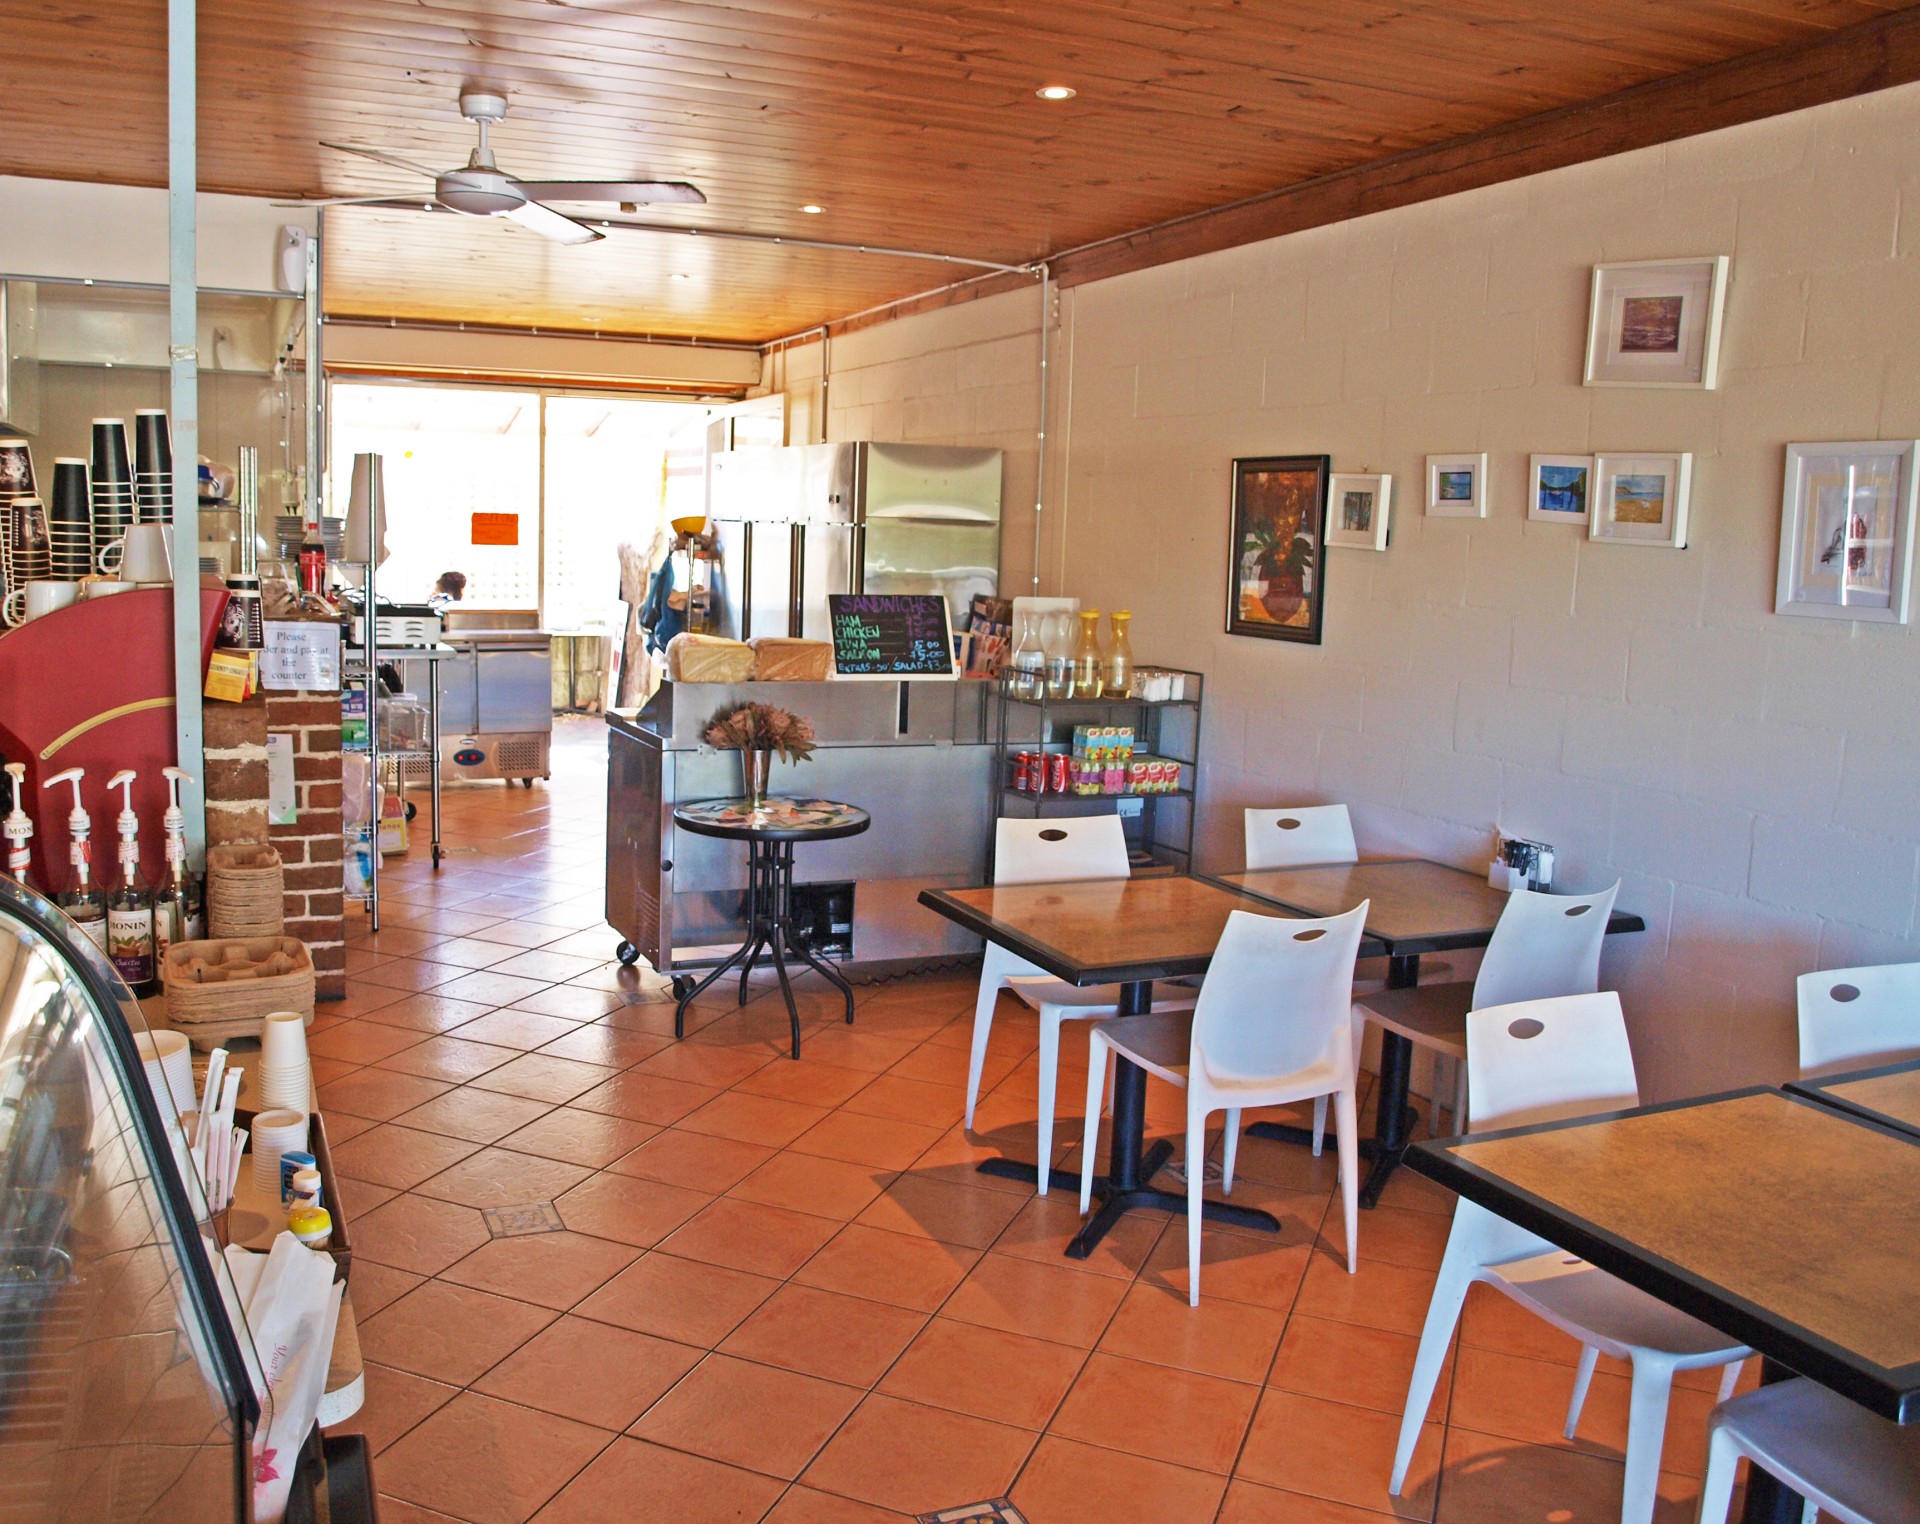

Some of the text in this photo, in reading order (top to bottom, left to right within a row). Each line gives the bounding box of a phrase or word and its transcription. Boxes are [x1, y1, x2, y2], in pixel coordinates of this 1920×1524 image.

[840, 595, 940, 613] SANDWICHES
[835, 614, 861, 627] HAM
[276, 631, 307, 641] Please
[835, 624, 880, 639] CHICKEN
[263, 644, 278, 654] der
[280, 644, 298, 654] and
[836, 639, 868, 649] TUNA
[836, 648, 880, 660] SALMON
[271, 671, 307, 680] counter
[270, 1341, 288, 1369] Your
